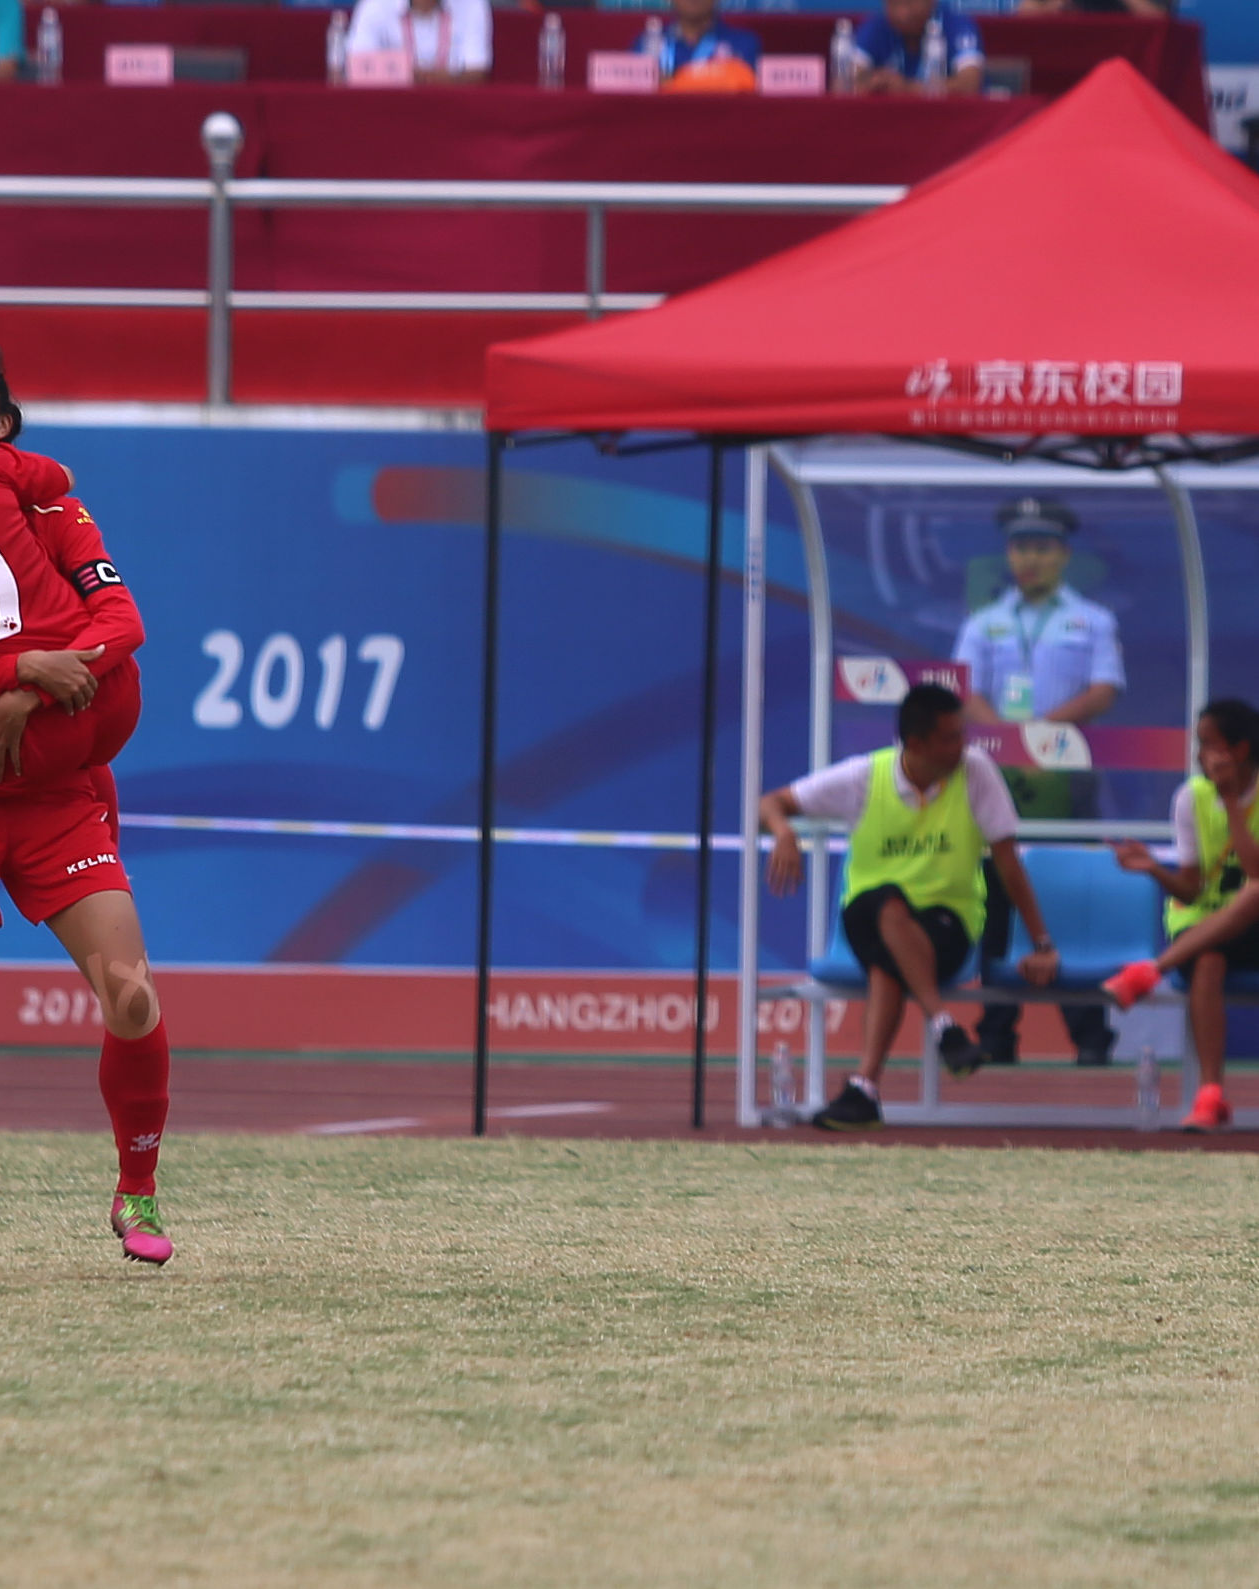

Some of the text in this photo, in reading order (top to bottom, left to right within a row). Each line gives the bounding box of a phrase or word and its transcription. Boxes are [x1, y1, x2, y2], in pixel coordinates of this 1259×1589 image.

[974, 359, 1184, 406] 京东校园
[96, 562, 122, 584] C
[192, 628, 405, 731] 2017
[66, 853, 118, 875] KELME
